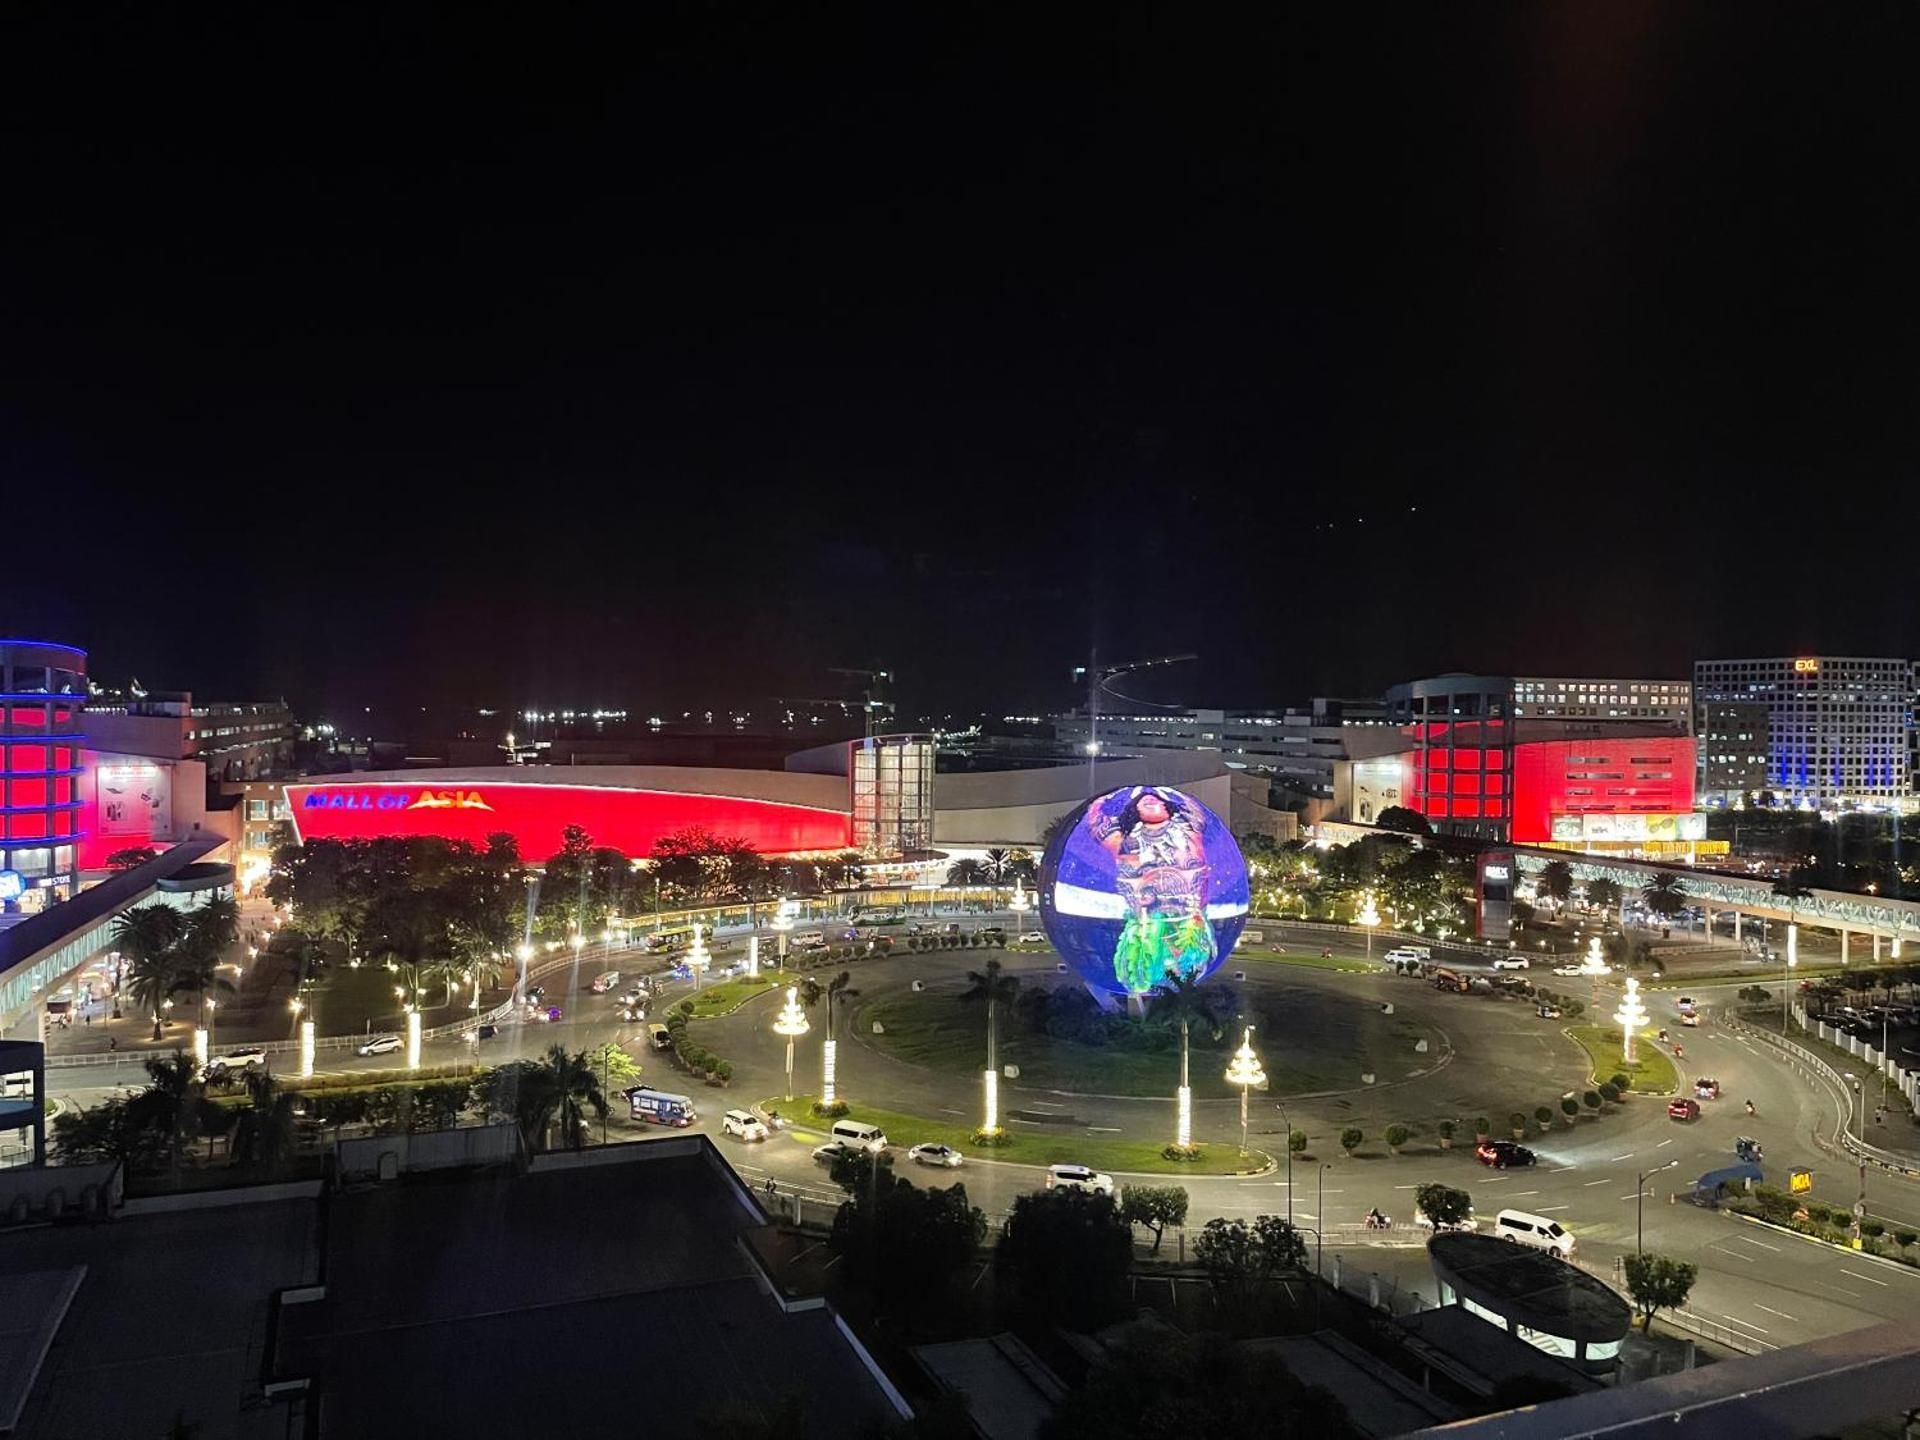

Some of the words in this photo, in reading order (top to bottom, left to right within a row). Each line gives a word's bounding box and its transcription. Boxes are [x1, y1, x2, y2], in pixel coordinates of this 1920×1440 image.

[1795, 659, 1818, 671] EXL
[305, 792, 373, 810] MALL
[377, 794, 409, 810] OF
[417, 790, 486, 809] ASIA
